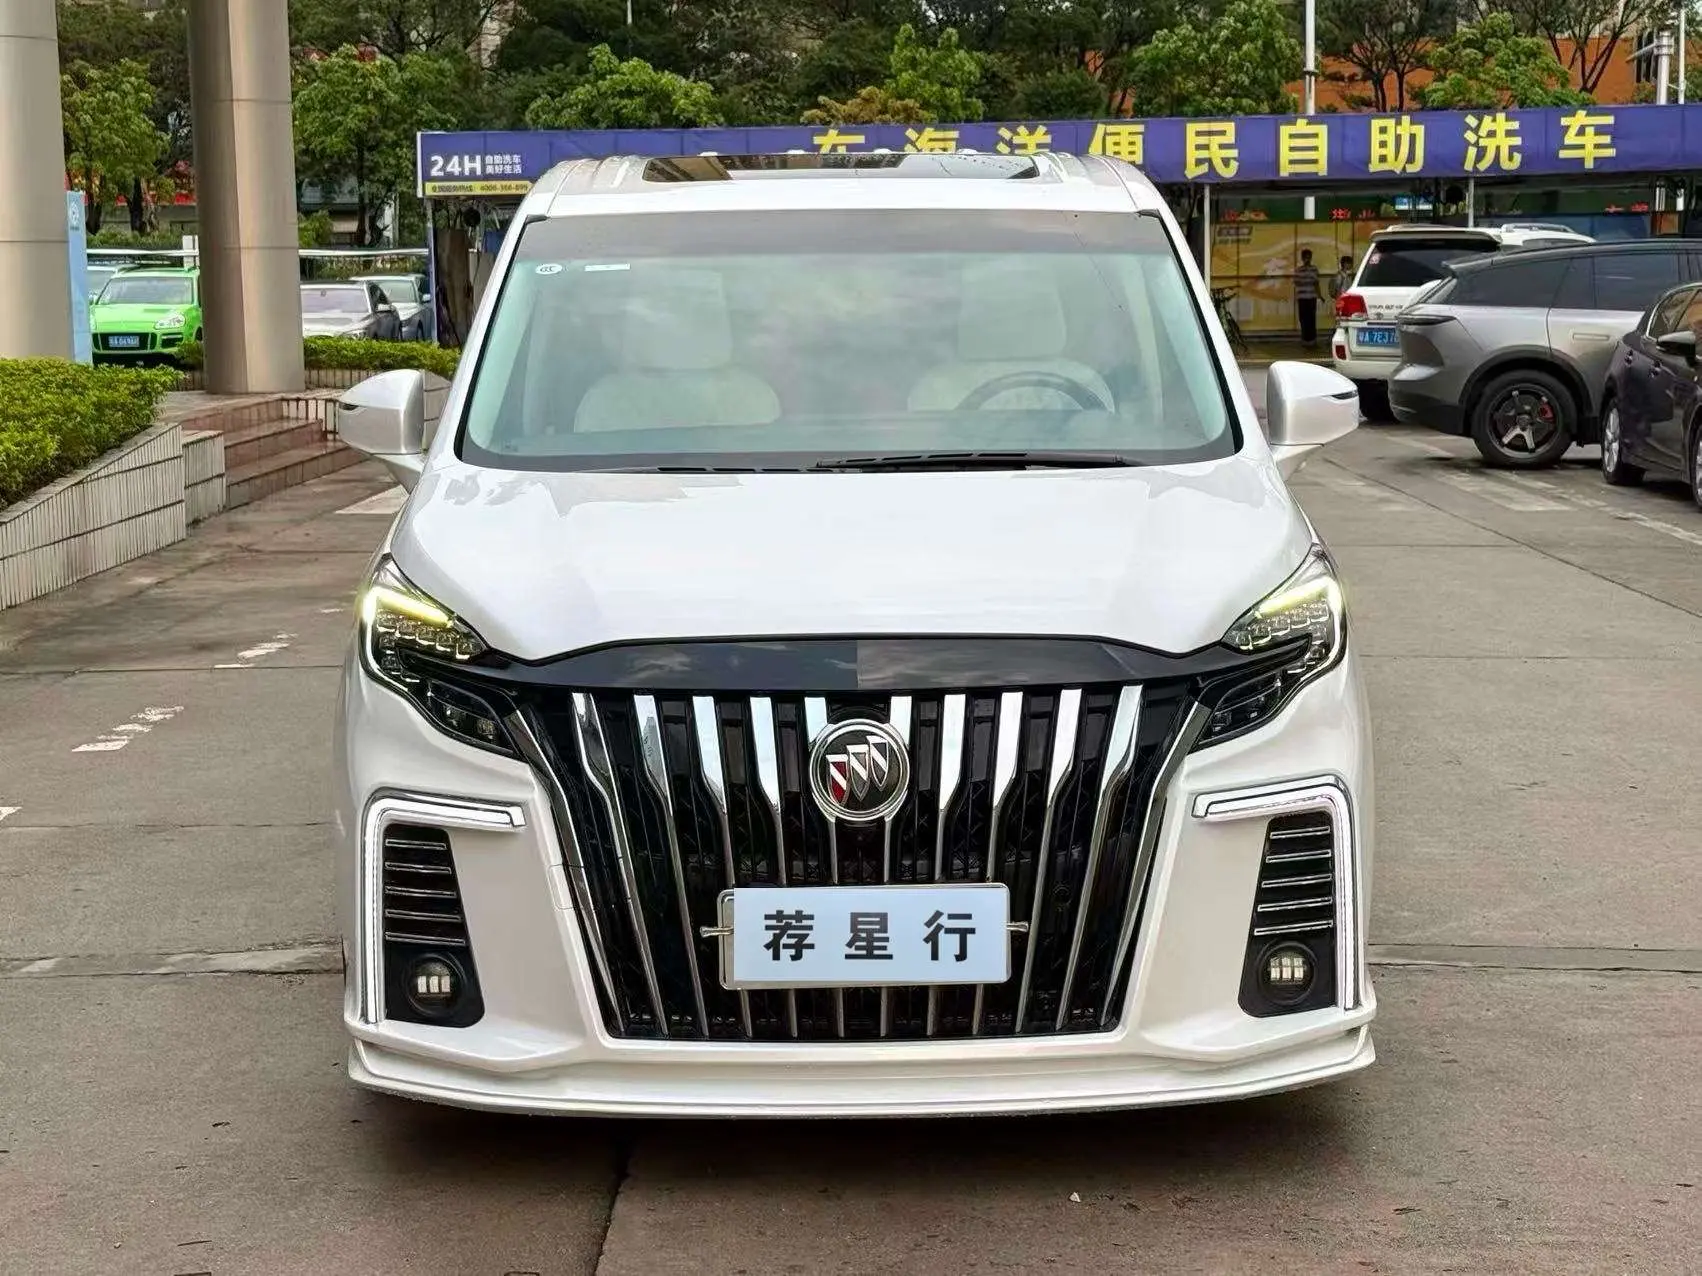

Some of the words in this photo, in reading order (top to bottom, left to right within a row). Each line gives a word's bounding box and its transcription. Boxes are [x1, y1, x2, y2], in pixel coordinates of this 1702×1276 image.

[430, 154, 482, 177] 24H
[485, 154, 522, 165] 自助洗车
[763, 910, 976, 962] 荐星行
